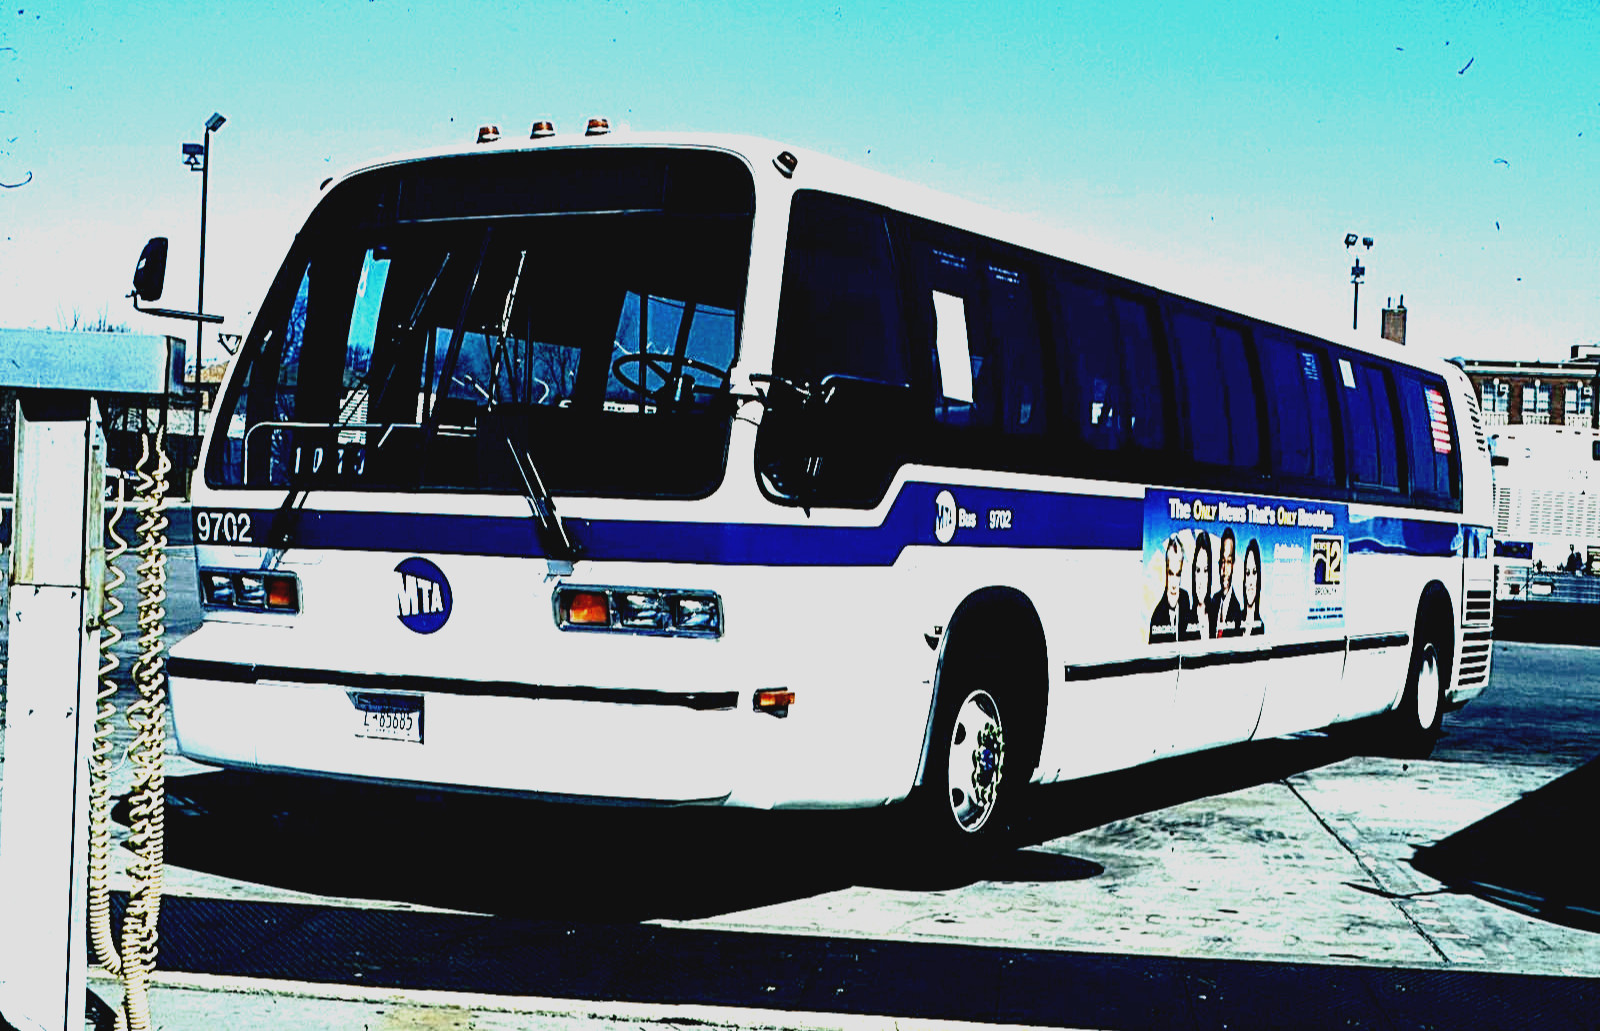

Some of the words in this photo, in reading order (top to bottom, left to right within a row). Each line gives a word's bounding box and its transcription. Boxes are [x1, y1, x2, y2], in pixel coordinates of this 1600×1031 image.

[959, 508, 977, 528] Bus
[989, 510, 1012, 529] 9702
[1168, 498, 1191, 519] The
[1218, 502, 1247, 523] News
[197, 512, 252, 543] 9702
[394, 570, 444, 616] MTA
